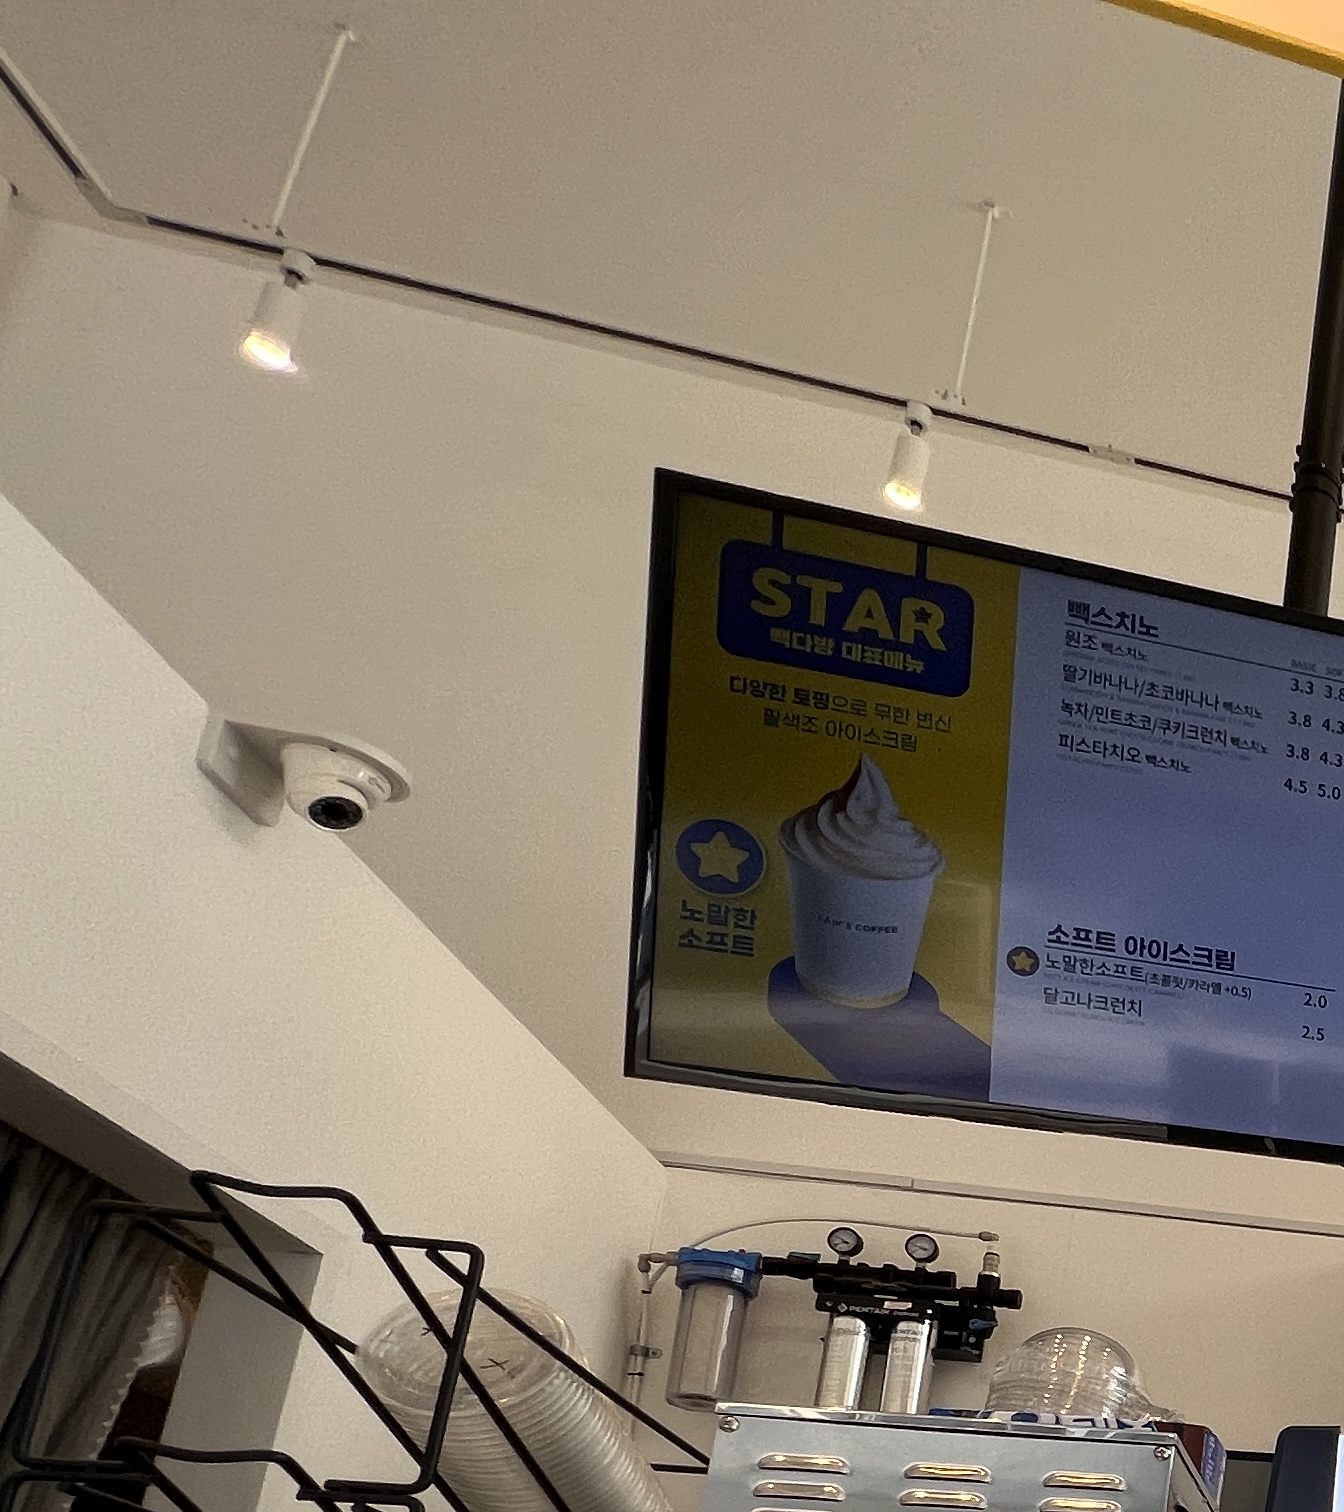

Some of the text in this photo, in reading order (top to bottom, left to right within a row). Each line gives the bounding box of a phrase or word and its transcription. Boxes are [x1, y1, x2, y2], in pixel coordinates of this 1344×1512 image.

[750, 566, 947, 651] STAR
[1067, 599, 1159, 638] 빽스치노
[769, 628, 925, 674] 빽다방 대표메뉴
[1065, 630, 1098, 651] 원조
[1062, 664, 1219, 712] 딸기바나나/초코바나나
[1290, 678, 1314, 696] 3.3
[729, 675, 952, 733] 다양한 토핑으로 무한 변신
[763, 709, 919, 753] 팔색조 아이스크림
[1060, 698, 1227, 747] 녹차/민트초코/쿠키크런치
[1288, 711, 1344, 734] 3.8 4.3
[1058, 733, 1142, 764] 피스타치오
[1286, 744, 1343, 768] 3.8 4.3
[1283, 778, 1341, 800] 4.5 5.0
[680, 899, 758, 931] 노말한
[677, 927, 755, 958] 소프트
[1047, 924, 1236, 971] 소프트 아이스크림
[1043, 986, 1144, 1018] 달고나크런치
[1303, 993, 1328, 1009] 2.0
[1301, 1025, 1325, 1041] 2.5
